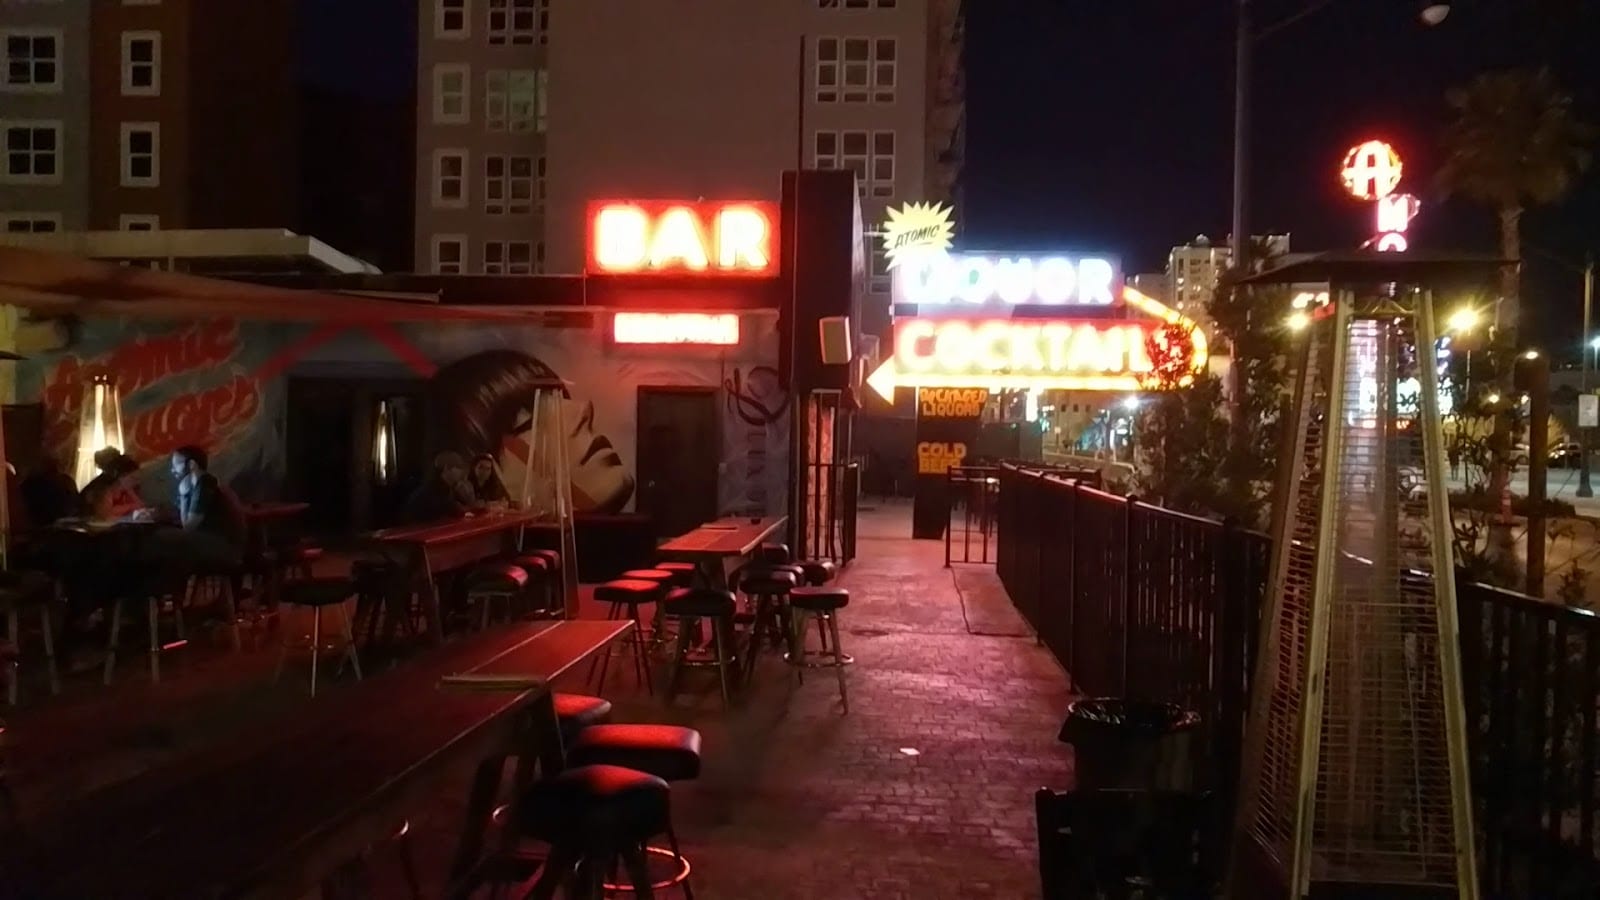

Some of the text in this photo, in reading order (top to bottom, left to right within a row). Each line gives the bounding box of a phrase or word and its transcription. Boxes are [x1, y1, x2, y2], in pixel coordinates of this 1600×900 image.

[595, 206, 770, 271] BAR
[894, 225, 940, 248] ATOMIC
[922, 401, 980, 417] LIQUORS
[917, 442, 967, 459] COLD
